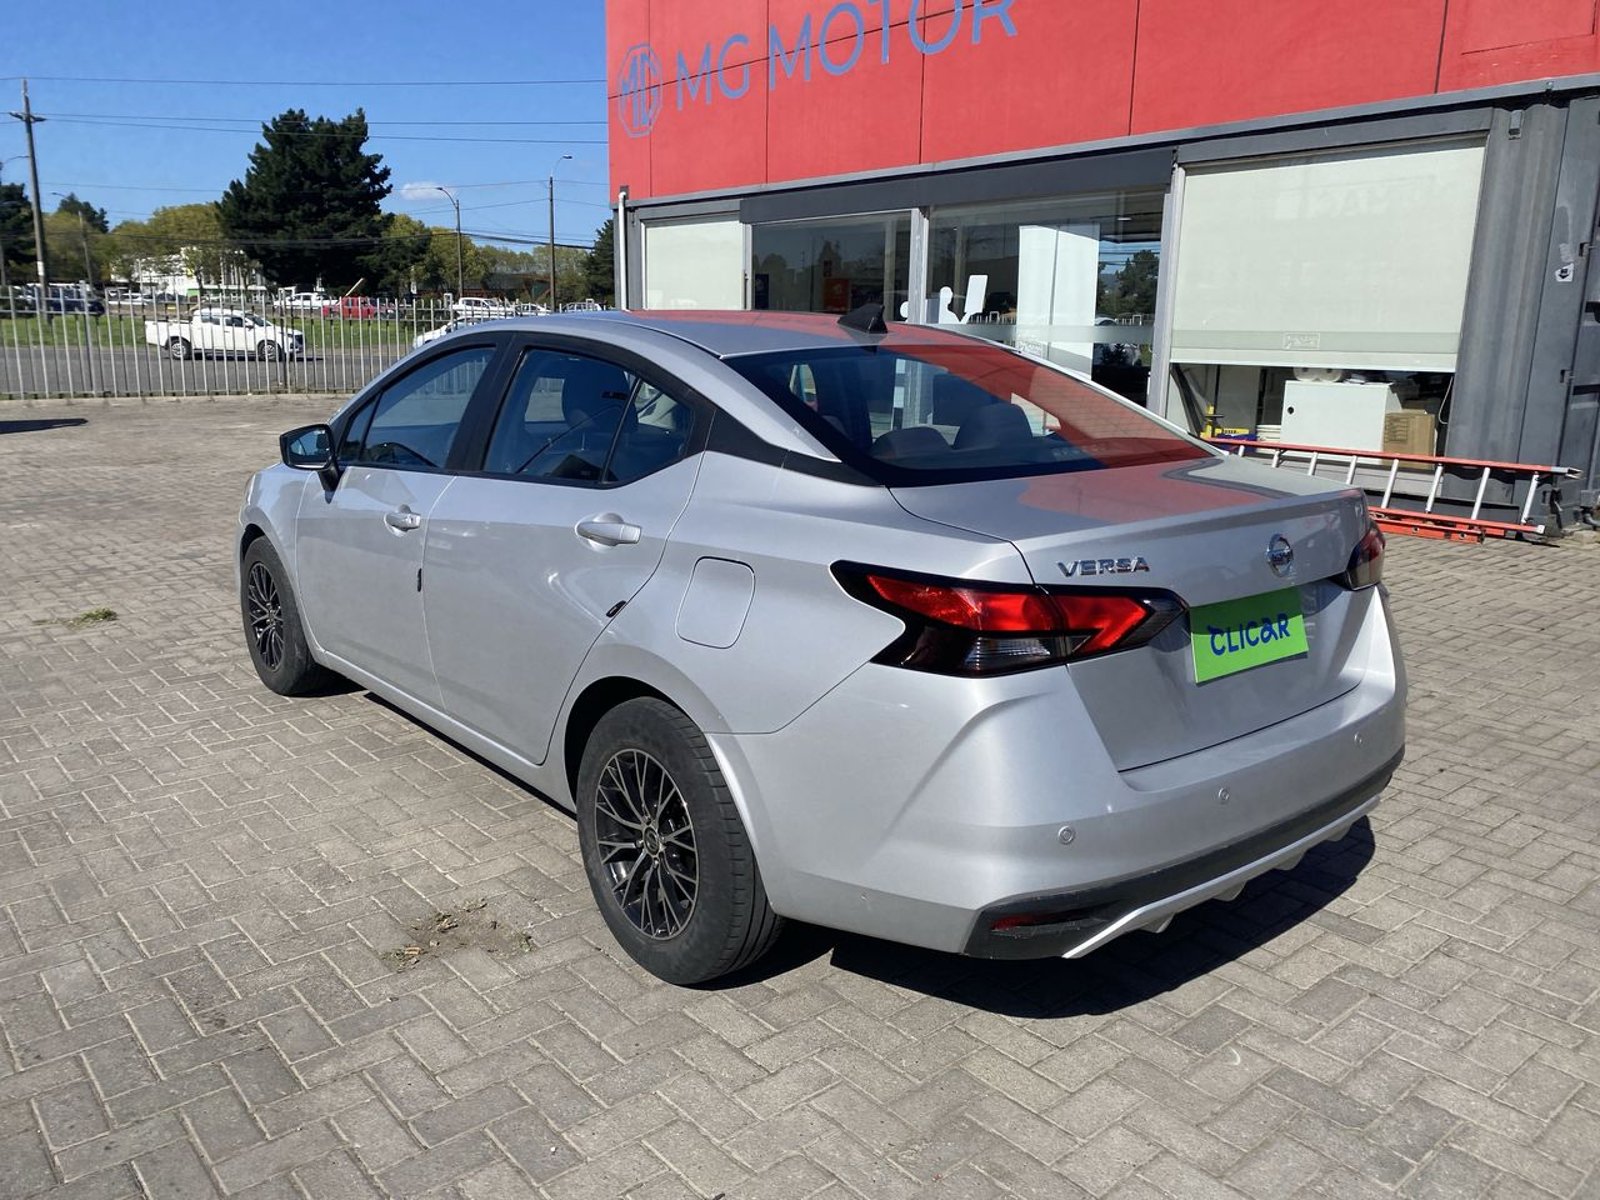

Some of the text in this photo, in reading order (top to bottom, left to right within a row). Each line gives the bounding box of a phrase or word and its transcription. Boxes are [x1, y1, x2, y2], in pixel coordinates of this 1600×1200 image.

[676, 0, 1018, 112] MG MOTOR
[1057, 556, 1150, 578] VERSA
